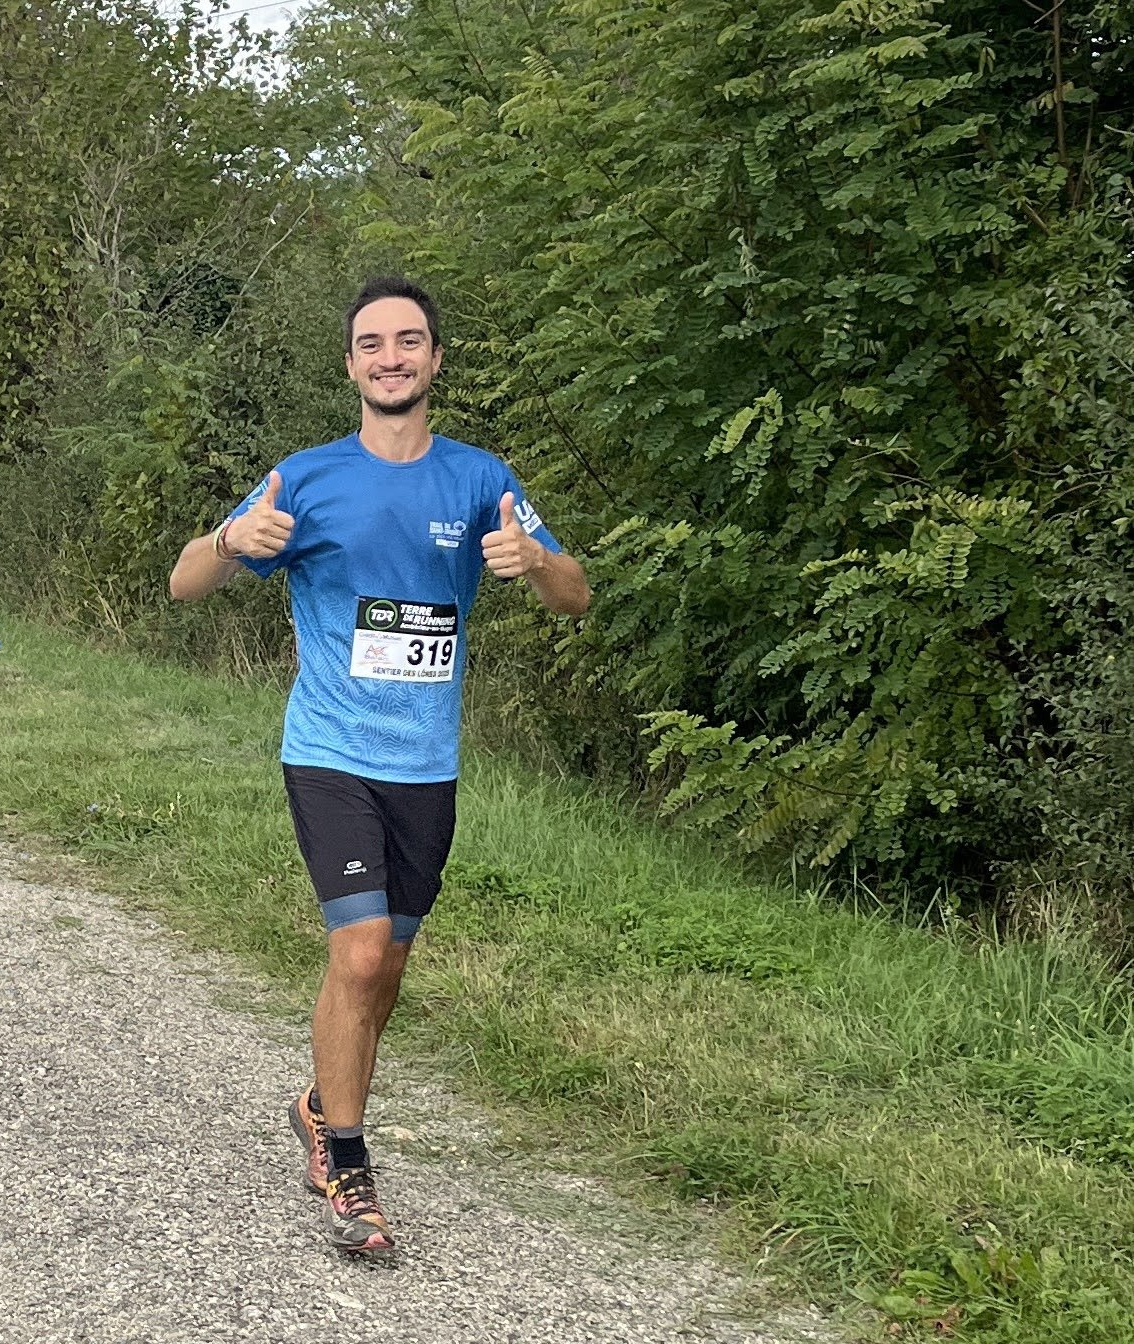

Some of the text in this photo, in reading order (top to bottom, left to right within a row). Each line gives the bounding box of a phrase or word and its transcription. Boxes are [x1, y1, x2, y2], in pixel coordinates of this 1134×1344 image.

[370, 608, 395, 622] TDR
[400, 604, 434, 616] TERRE
[413, 615, 456, 626] RUNNING
[406, 638, 454, 667] 319
